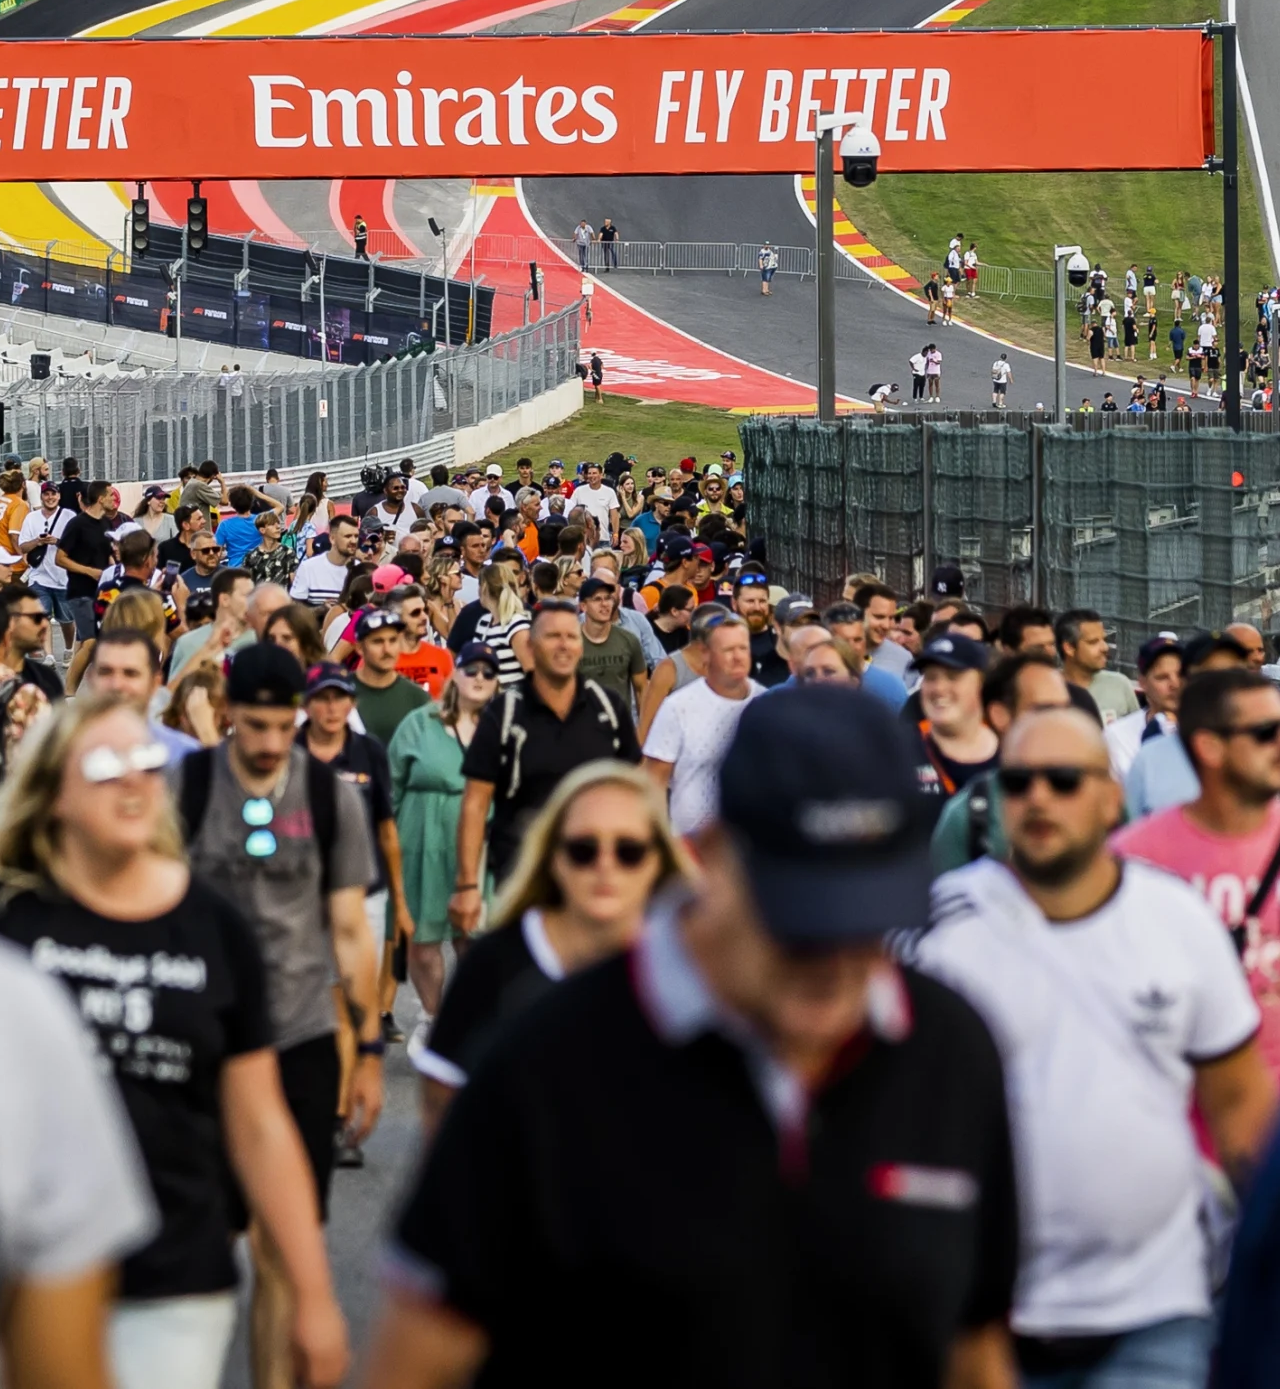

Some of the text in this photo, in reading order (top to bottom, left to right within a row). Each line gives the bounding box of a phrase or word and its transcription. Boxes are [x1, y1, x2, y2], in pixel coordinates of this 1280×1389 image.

[248, 68, 951, 148] Emirates FLY BETTER
